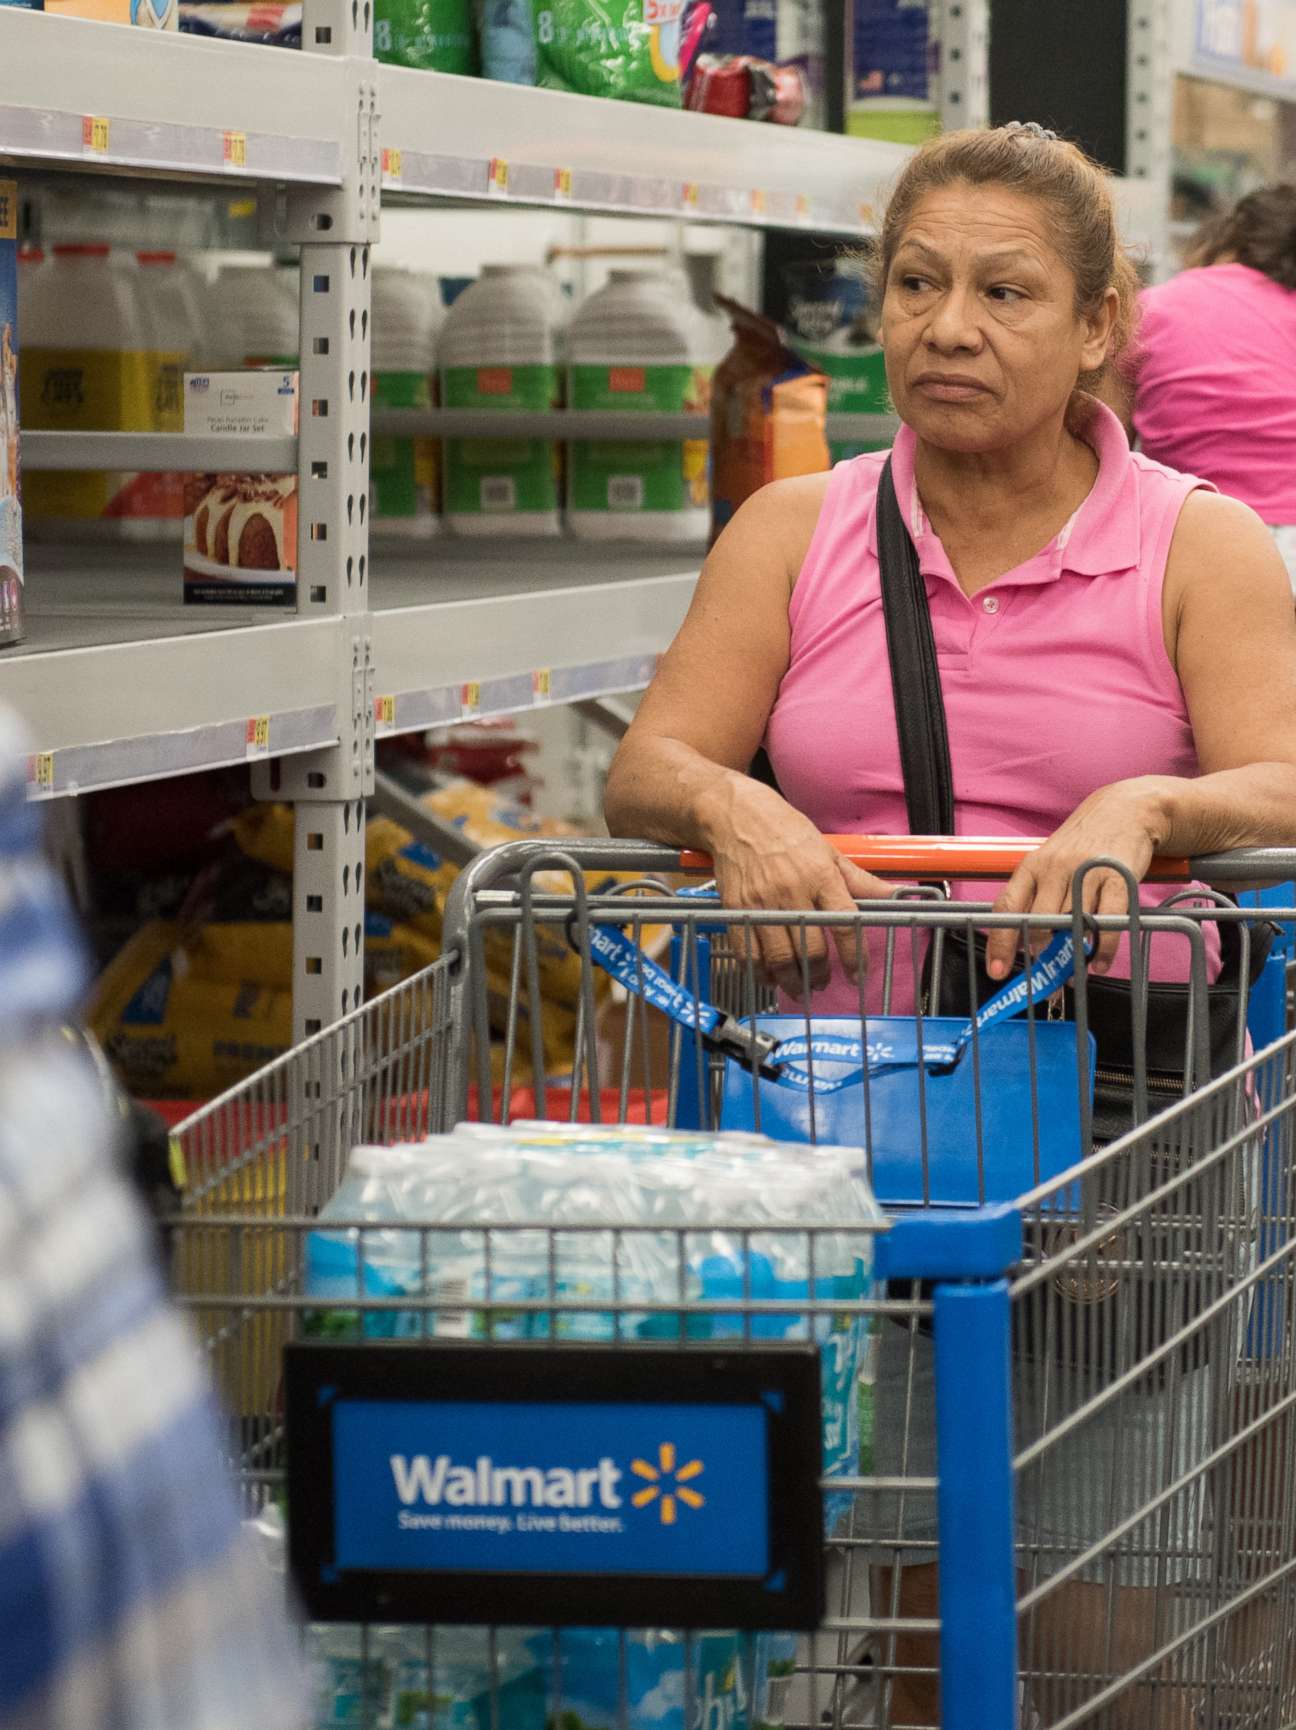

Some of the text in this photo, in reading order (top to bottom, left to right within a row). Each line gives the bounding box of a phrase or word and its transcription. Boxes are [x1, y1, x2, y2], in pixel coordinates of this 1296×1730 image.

[775, 1040, 860, 1059] Wamart
[389, 1454, 623, 1509] Walmart
[399, 1510, 445, 1531] Save
[516, 1511, 557, 1532] Live
[558, 1512, 624, 1533] better.
